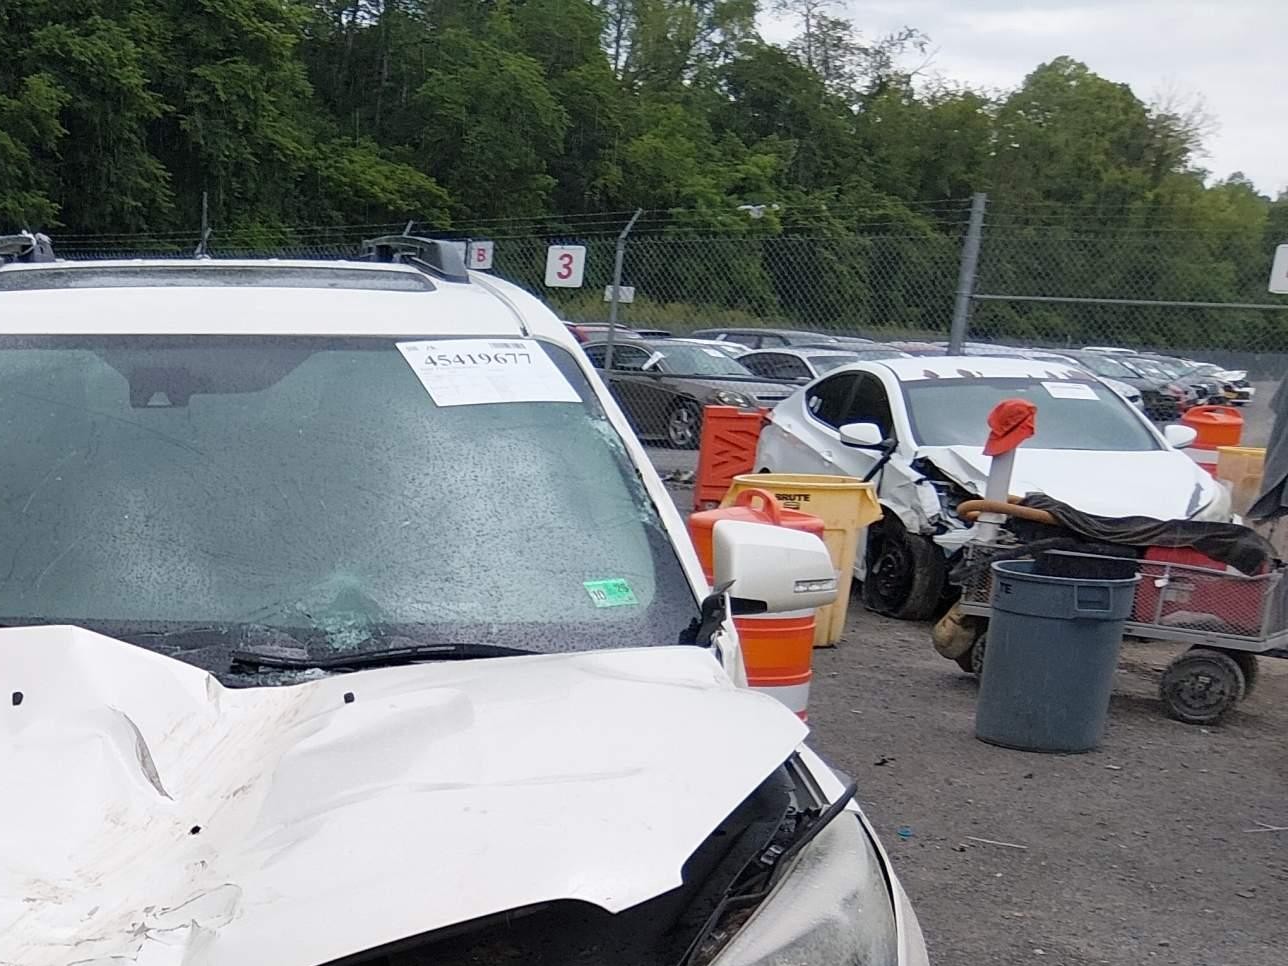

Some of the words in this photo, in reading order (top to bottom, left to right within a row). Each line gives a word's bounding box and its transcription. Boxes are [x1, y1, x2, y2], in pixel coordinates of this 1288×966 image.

[476, 248, 487, 263] B
[556, 253, 573, 280] 3
[424, 352, 532, 367] 45419677
[592, 590, 607, 601] 10
